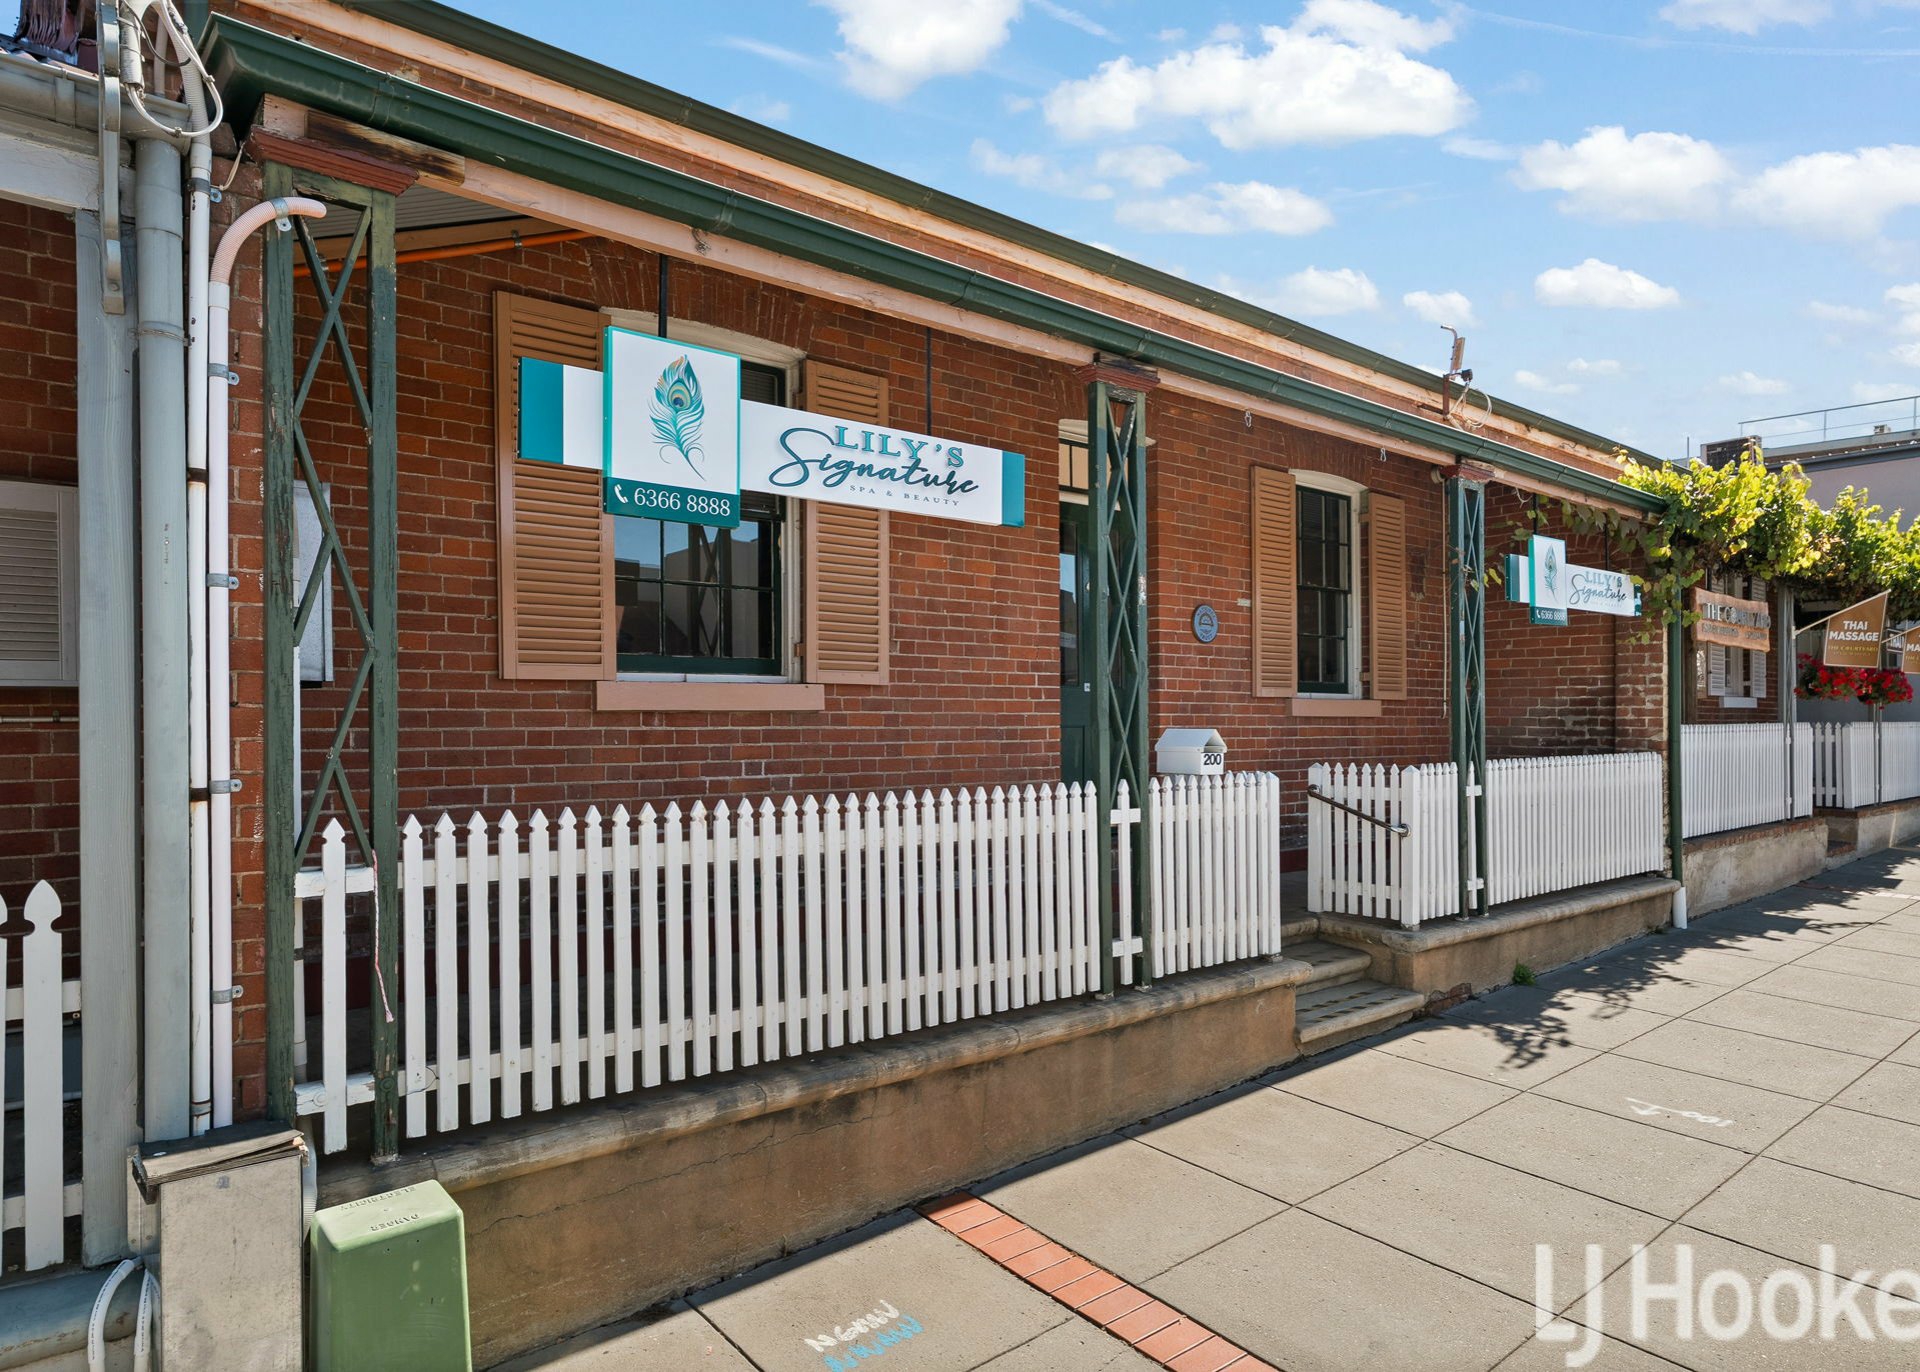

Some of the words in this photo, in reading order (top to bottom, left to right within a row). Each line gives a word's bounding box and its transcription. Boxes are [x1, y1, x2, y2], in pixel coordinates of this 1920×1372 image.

[834, 425, 965, 467] LILY'S
[768, 427, 979, 495] Signature
[634, 487, 680, 510] 6366
[686, 494, 731, 517] 8888
[849, 484, 876, 495] SPA
[886, 490, 894, 498] &
[903, 493, 961, 507] BEAUTY
[1569, 573, 1627, 605] Signature
[1829, 631, 1879, 641] MASSAGE
[1843, 620, 1868, 630] THAI
[1203, 753, 1222, 766] 200
[340, 1185, 416, 1211] ELECTRICITY
[370, 1213, 420, 1232] DANGER
